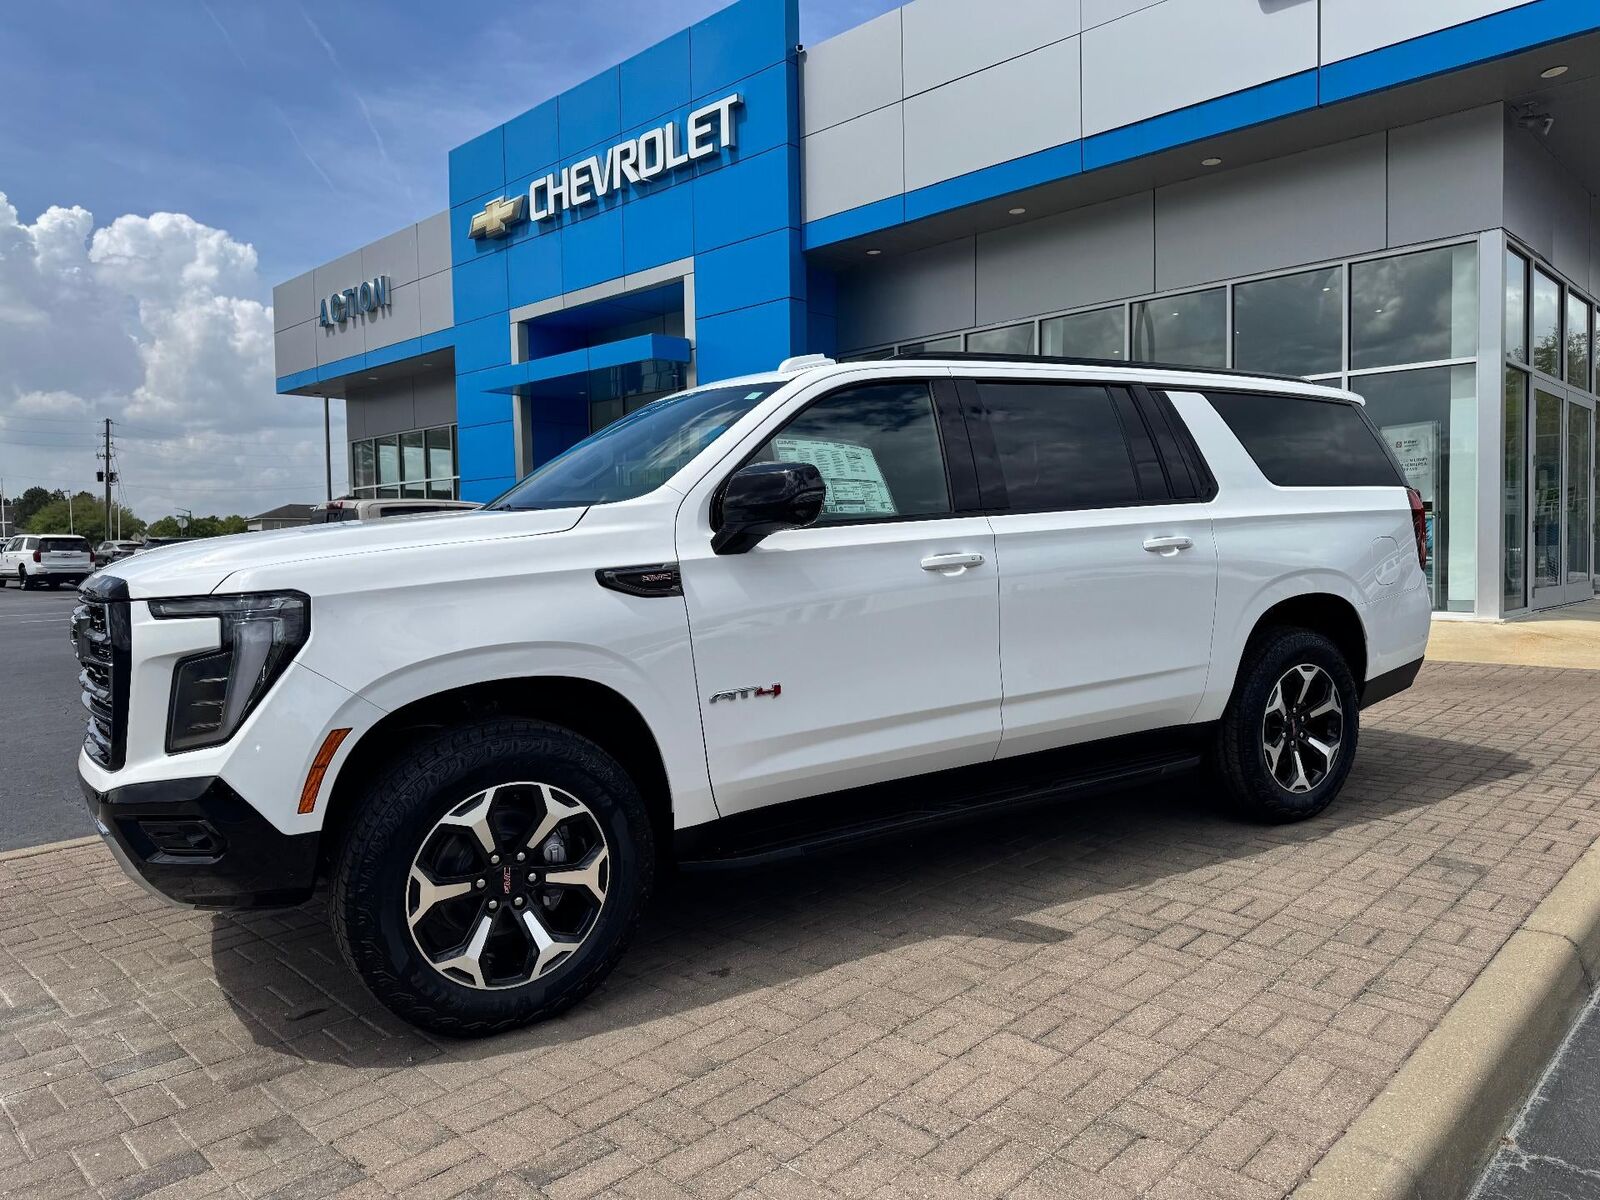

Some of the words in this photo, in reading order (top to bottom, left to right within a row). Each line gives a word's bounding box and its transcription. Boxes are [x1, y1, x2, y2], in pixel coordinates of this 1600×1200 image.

[528, 93, 743, 222] CHEVROLET
[319, 275, 391, 328] ACTION
[709, 682, 781, 704] AT4
